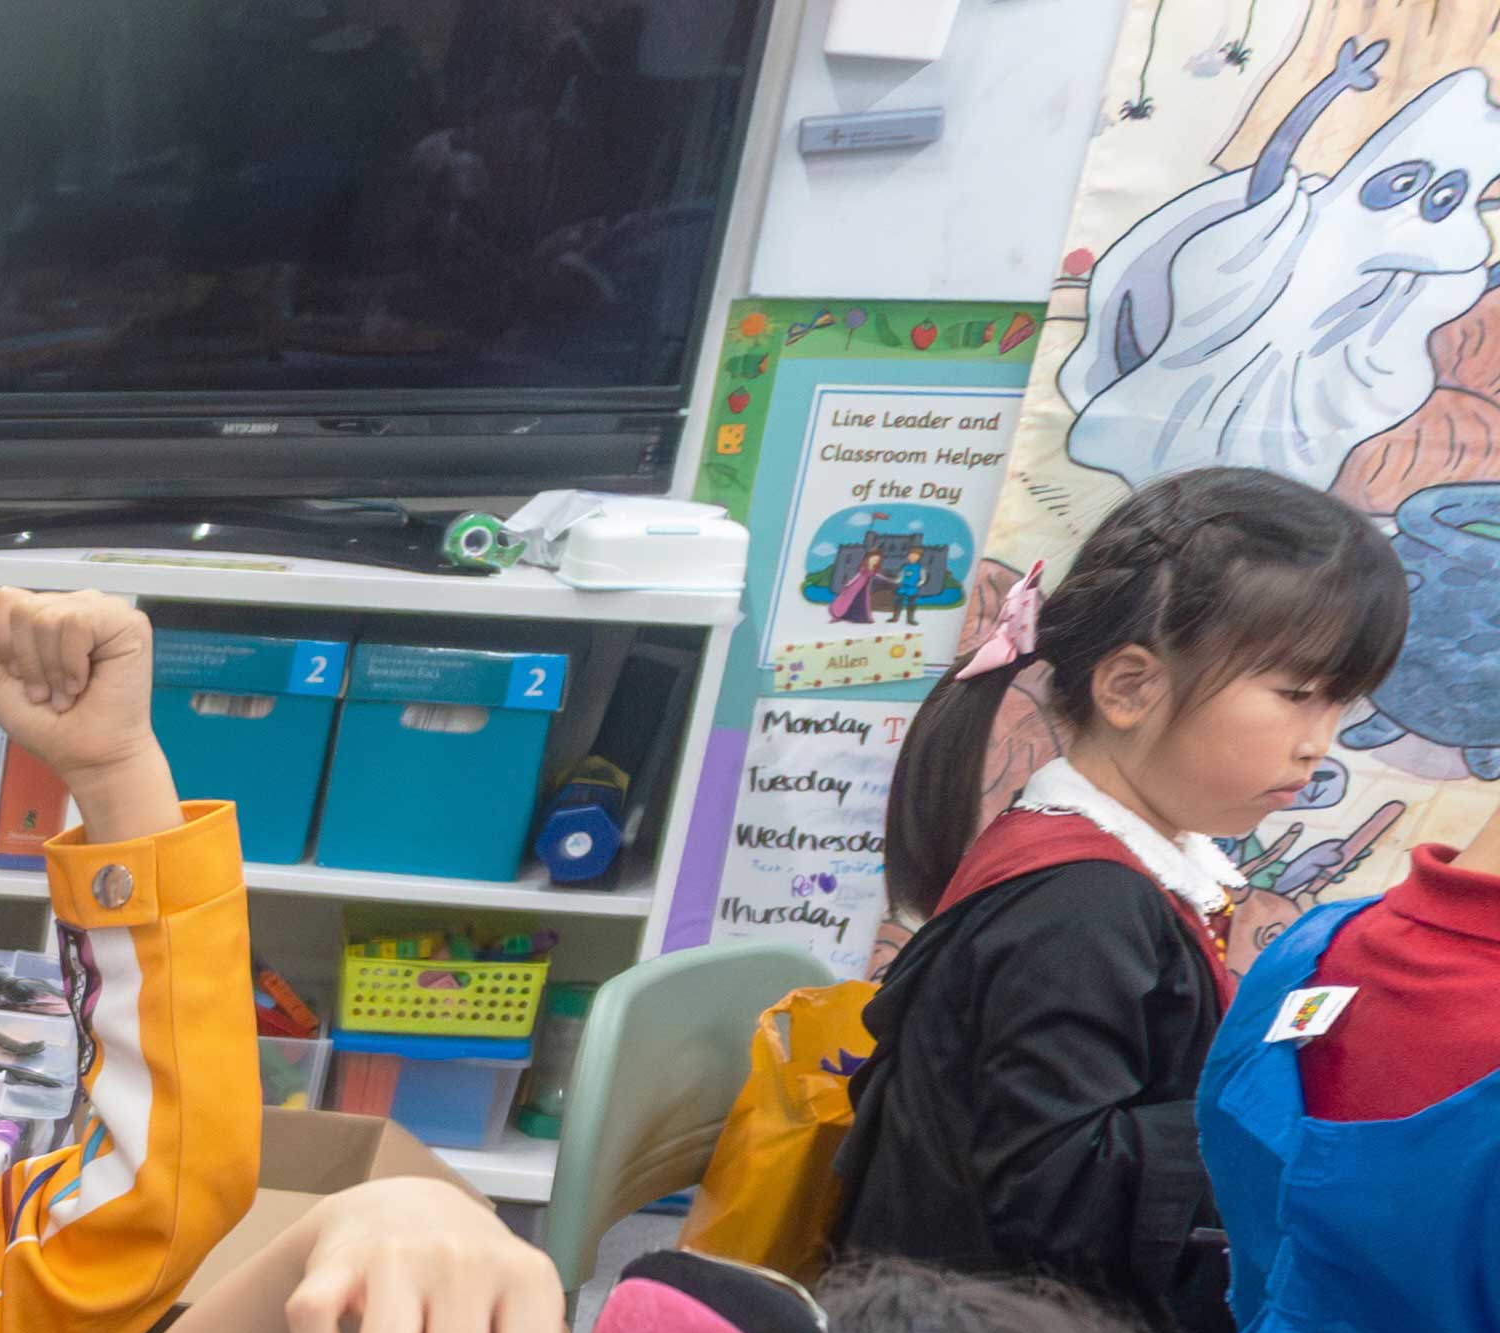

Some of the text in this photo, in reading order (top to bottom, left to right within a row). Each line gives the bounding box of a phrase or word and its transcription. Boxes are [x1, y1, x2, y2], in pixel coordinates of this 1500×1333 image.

[832, 409, 1001, 431] Line Leader and
[820, 444, 1006, 469] Classroom Helper
[852, 479, 963, 504] of the Day
[304, 656, 328, 683] 2
[827, 654, 869, 670] Allen
[523, 669, 547, 696] 2
[762, 710, 872, 744] Monday
[748, 766, 852, 805] Tuesday
[736, 824, 886, 853] Wednesda
[721, 897, 849, 943] Thursday
